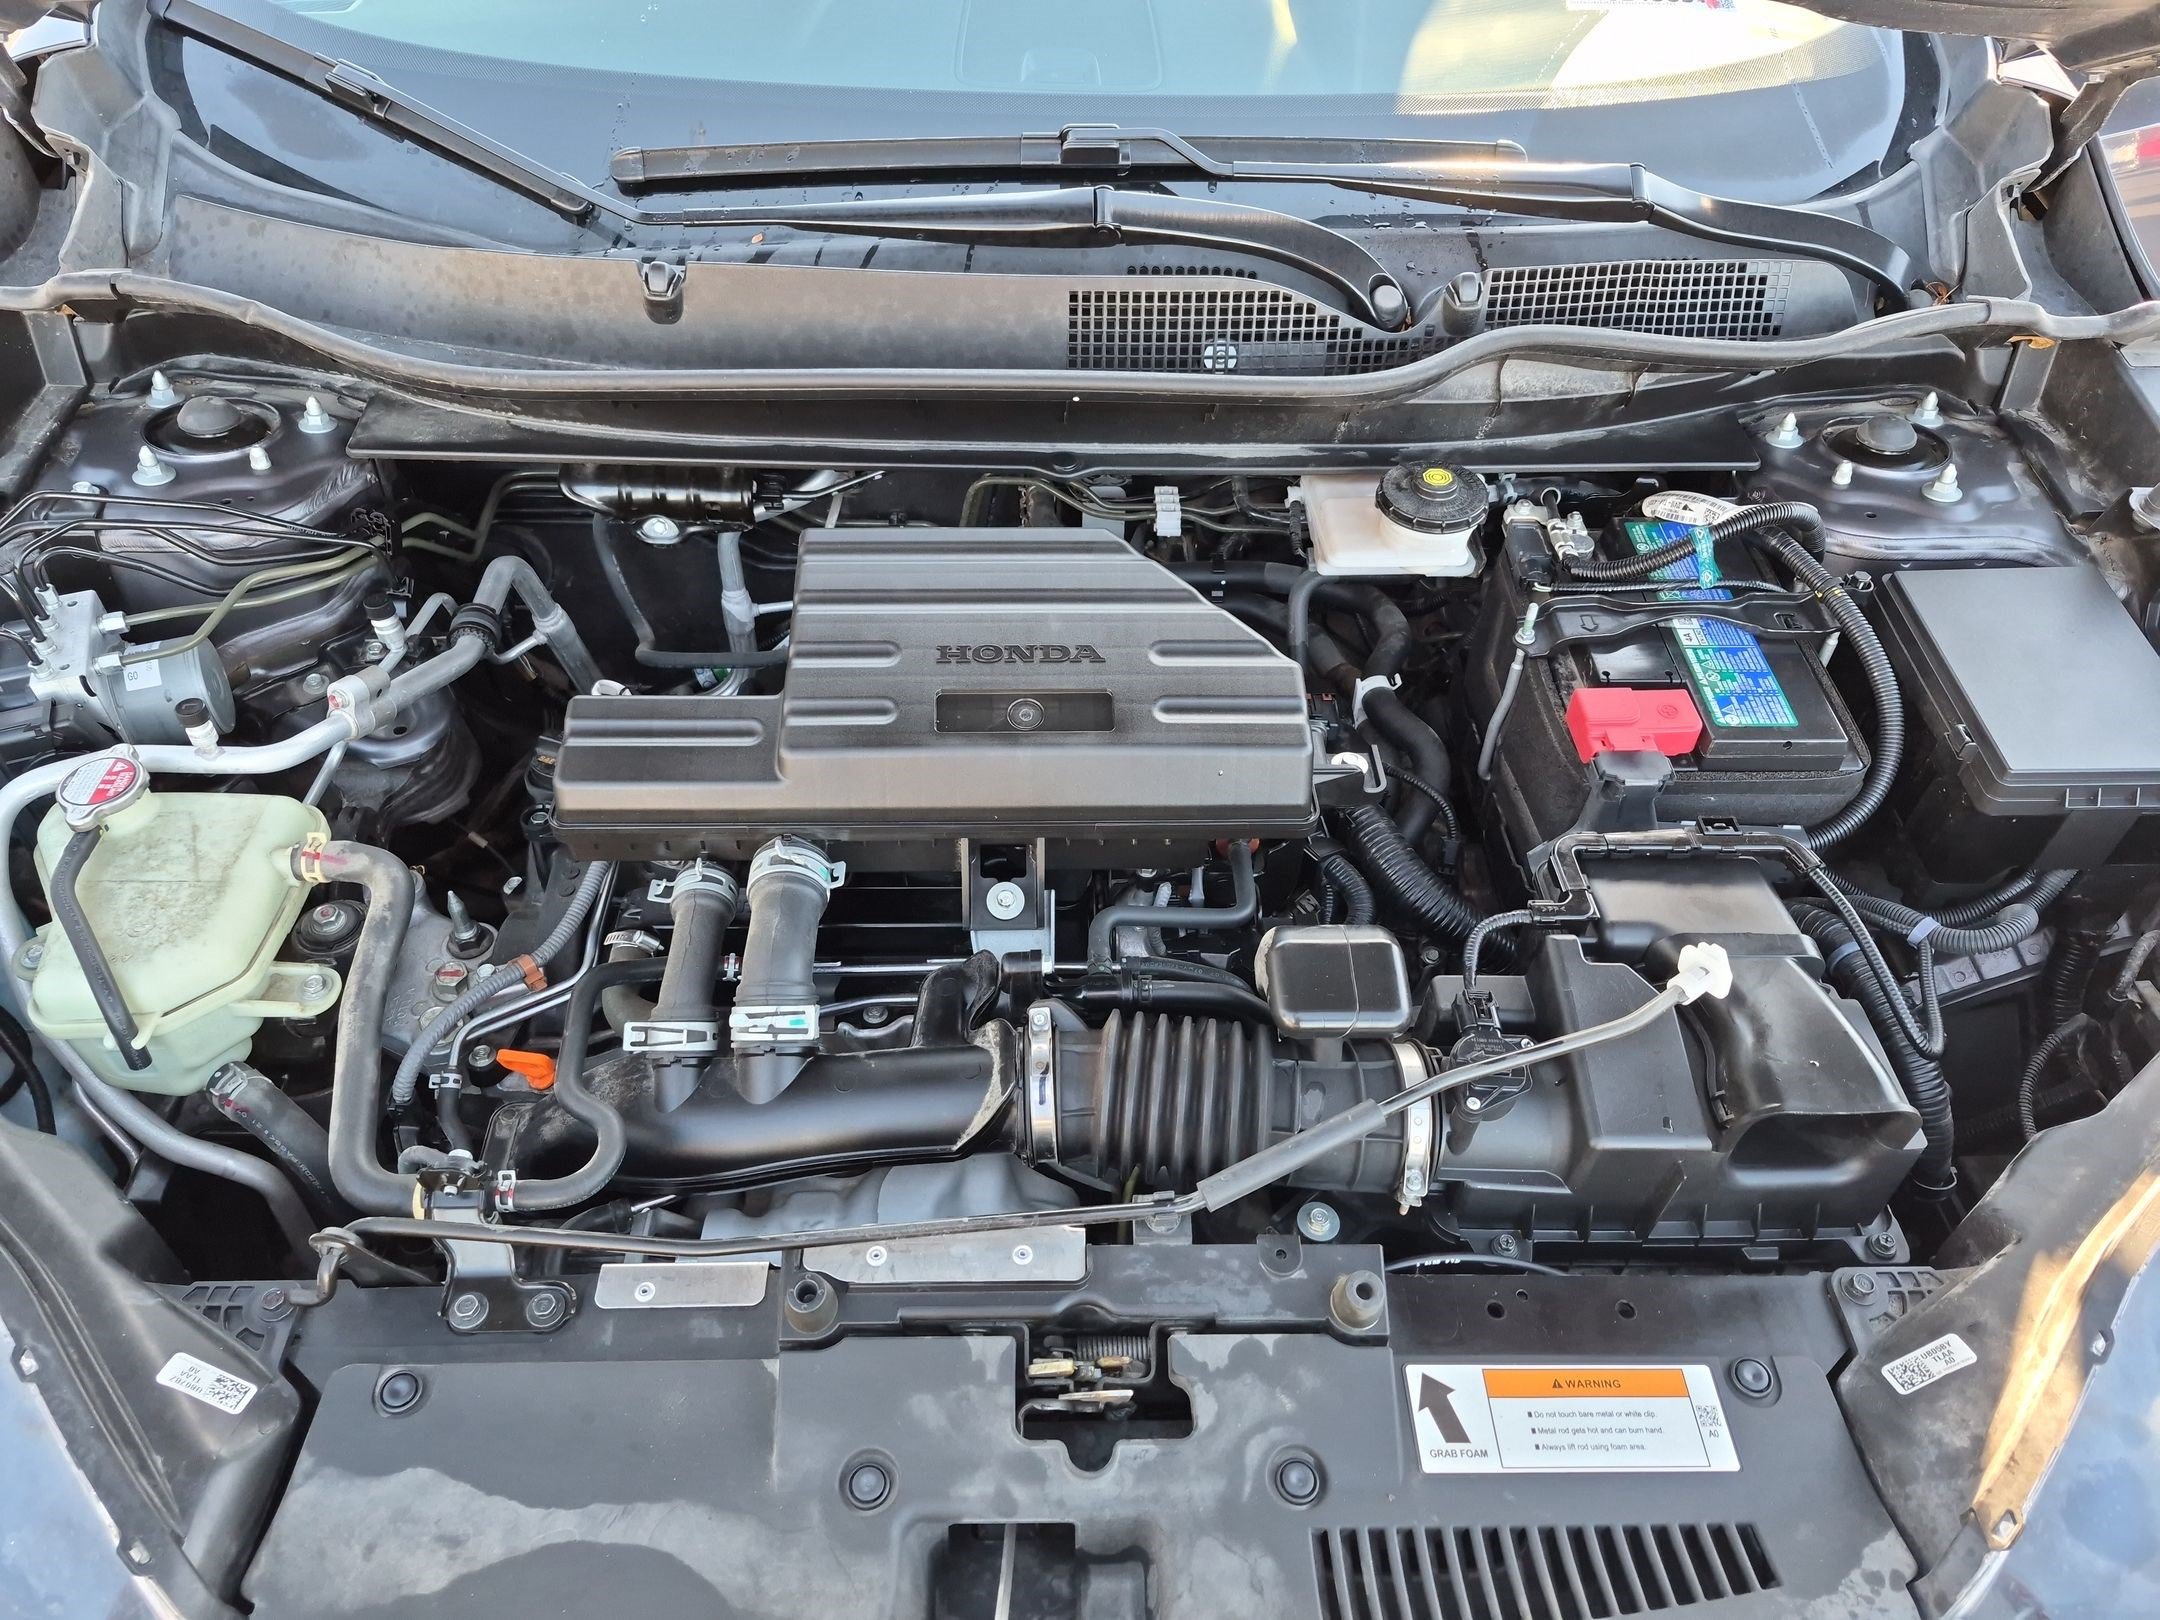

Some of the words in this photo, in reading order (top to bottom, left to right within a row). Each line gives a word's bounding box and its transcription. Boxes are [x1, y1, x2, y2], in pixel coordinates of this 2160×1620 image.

[936, 644, 1106, 664] HONDA
[1565, 1379, 1622, 1389] WARNING
[1625, 1410, 1642, 1418] white
[1571, 1428, 1586, 1436] gets
[1542, 1443, 1566, 1452] Always
[1590, 1443, 1609, 1452] using
[1429, 1449, 1458, 1458] GRAB
[1460, 1449, 1489, 1458] FOAM
